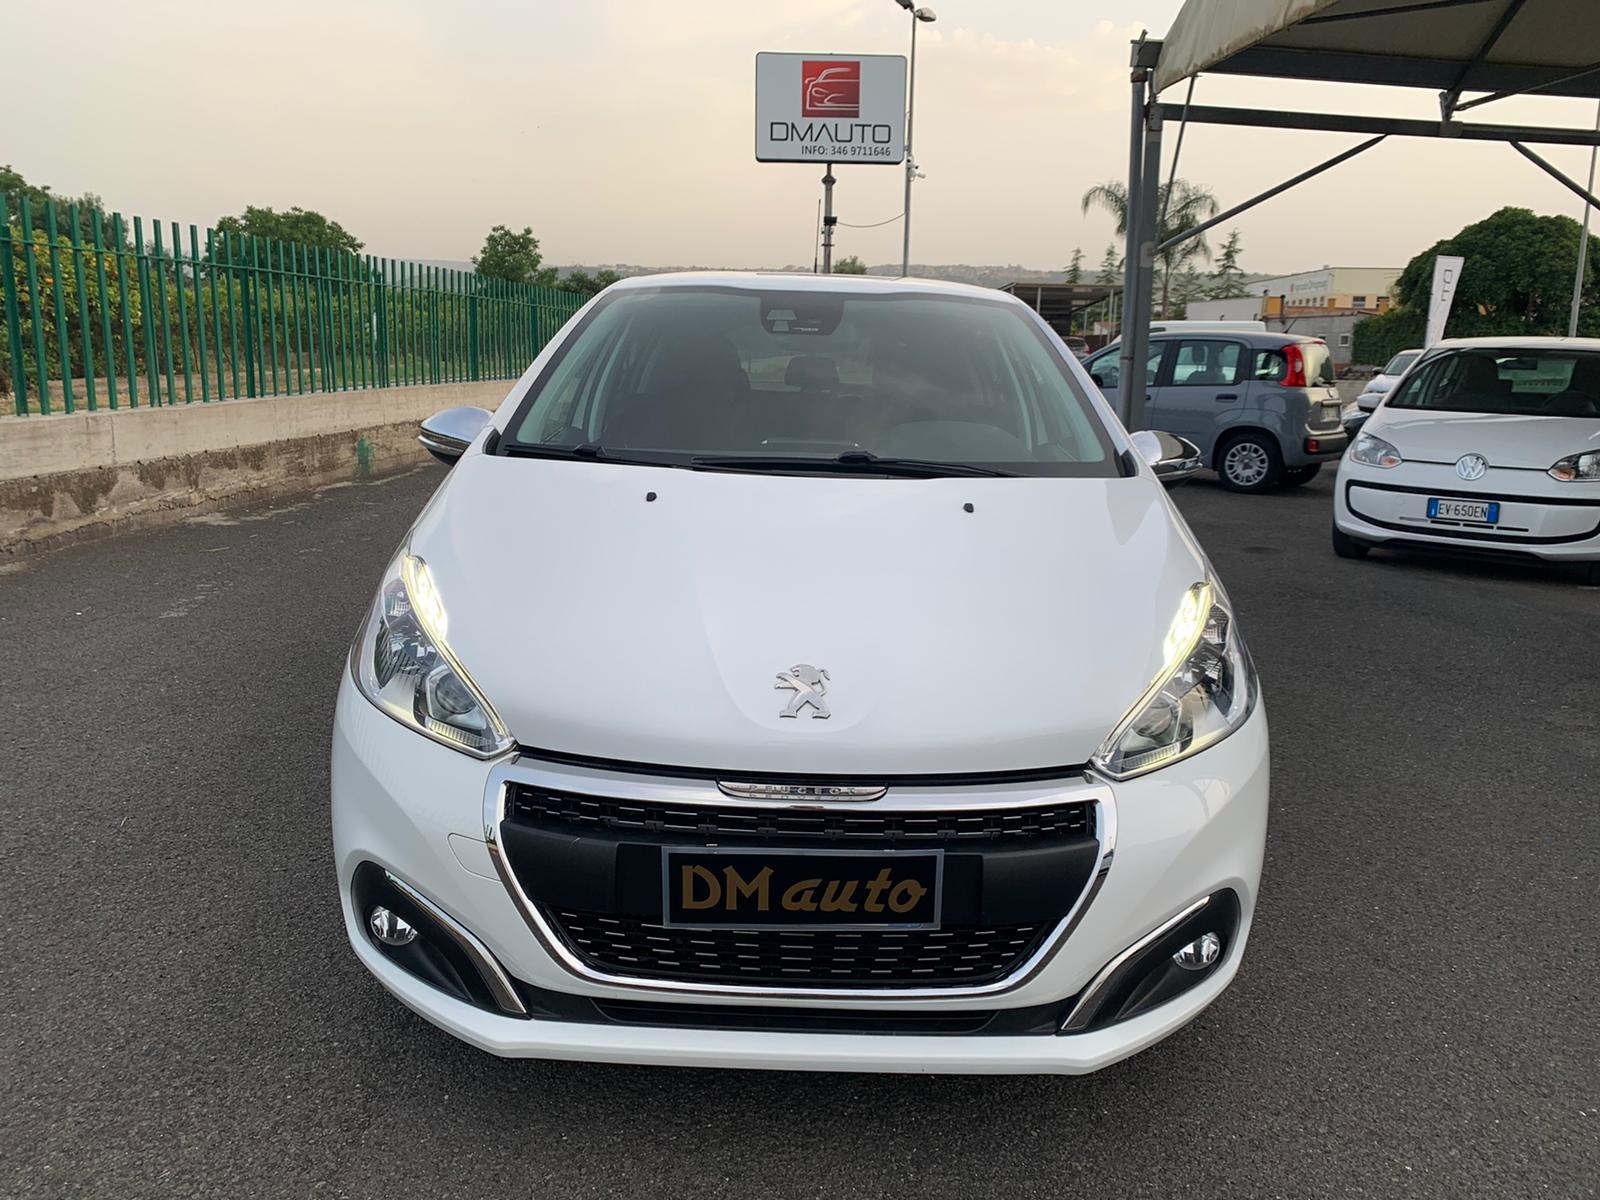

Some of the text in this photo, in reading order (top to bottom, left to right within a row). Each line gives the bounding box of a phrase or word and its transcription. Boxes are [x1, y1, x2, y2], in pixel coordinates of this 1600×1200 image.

[769, 121, 892, 144] DMAUTO
[801, 145, 891, 157] INFO: 346 9711646
[681, 864, 928, 914] DM auto
